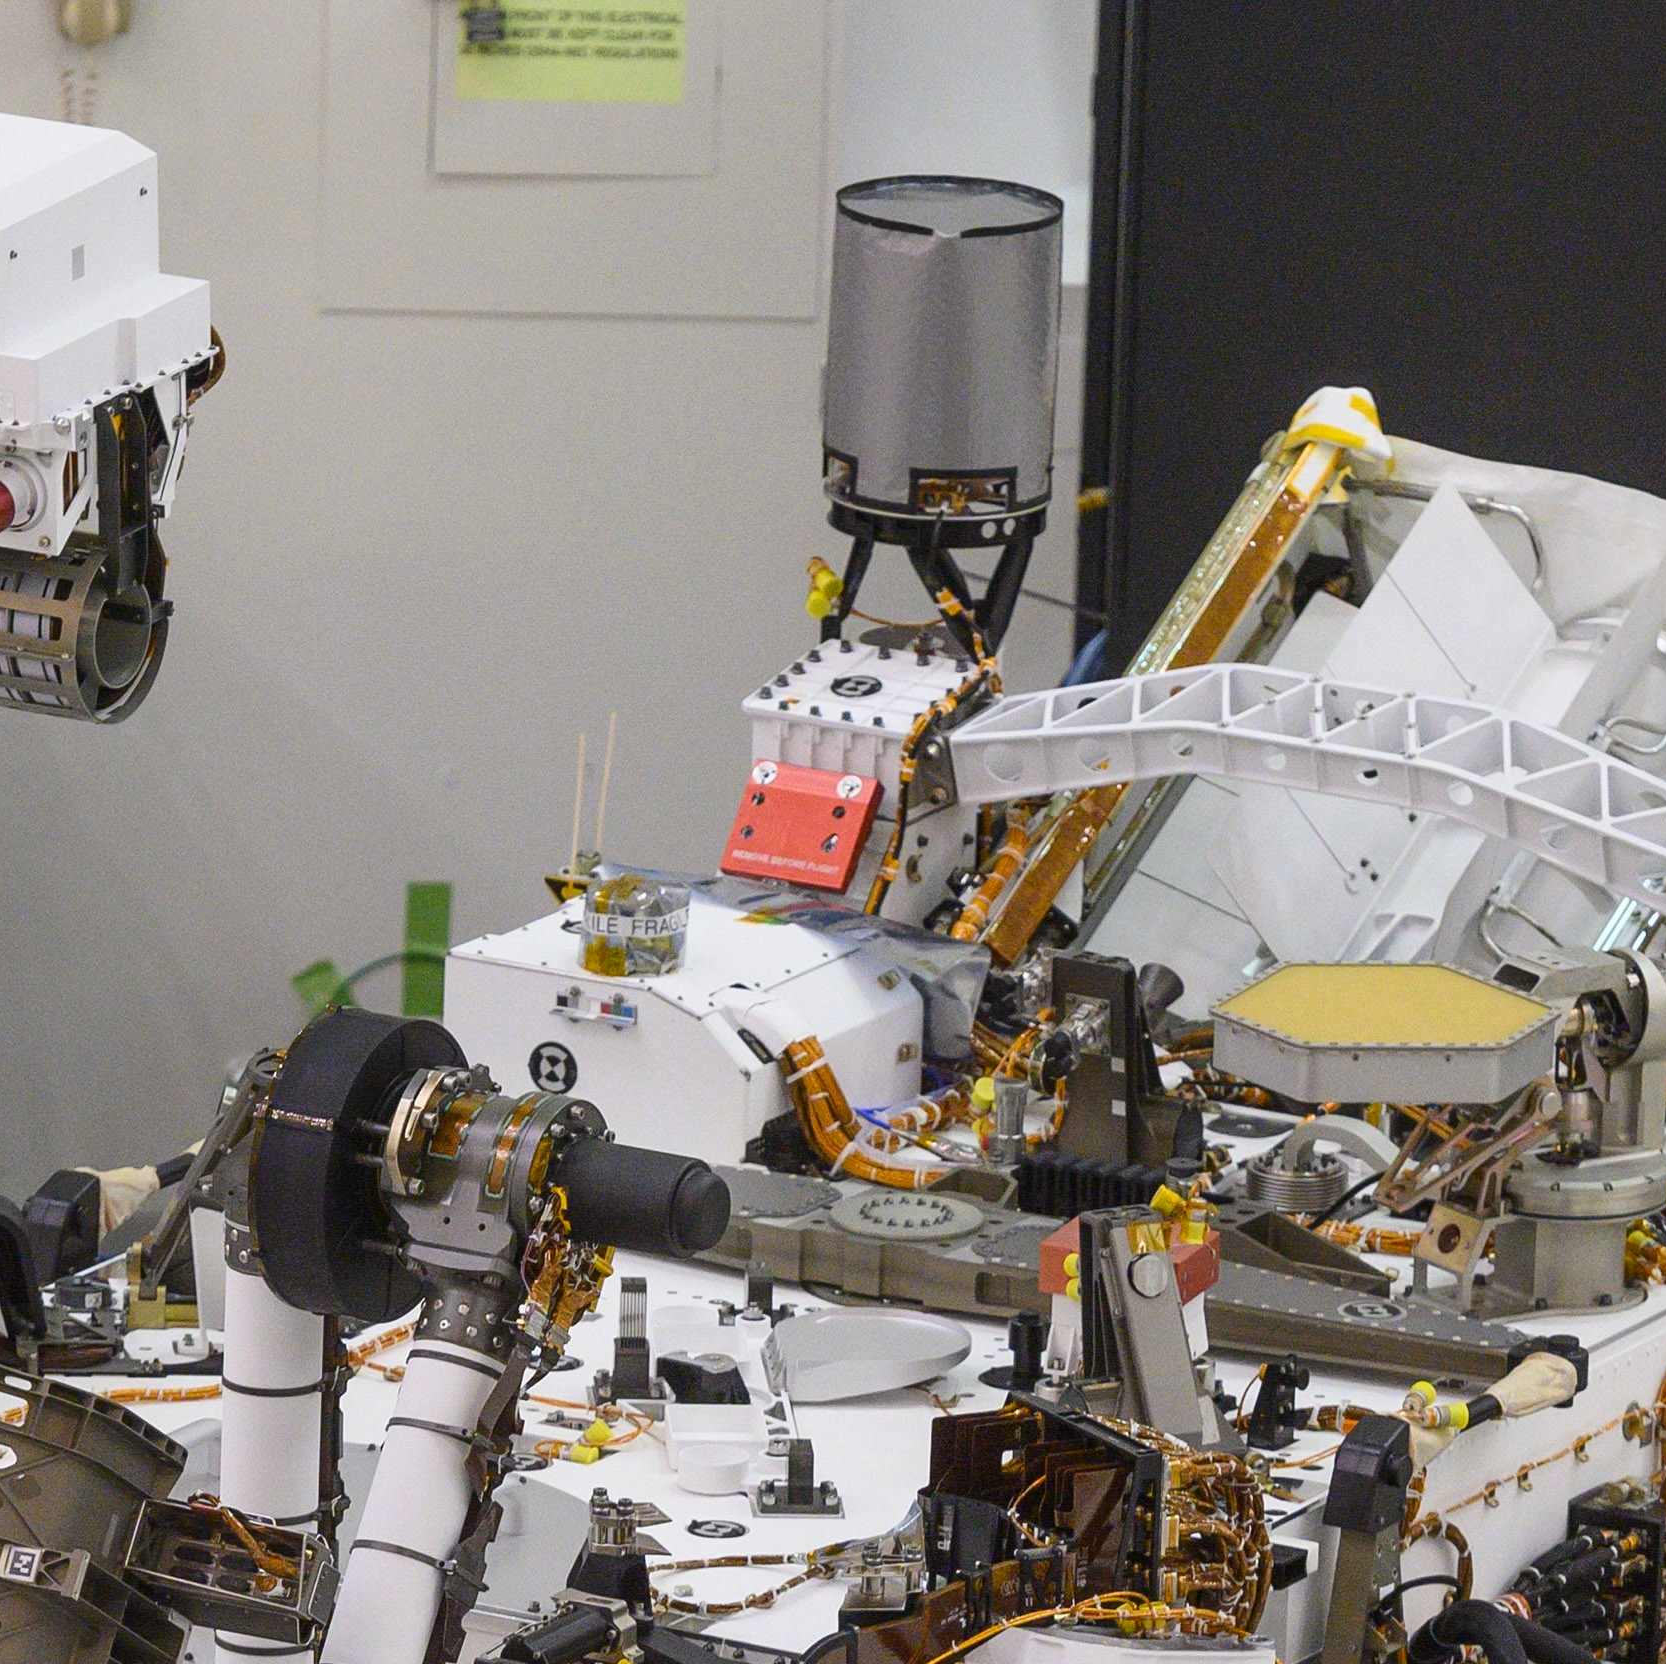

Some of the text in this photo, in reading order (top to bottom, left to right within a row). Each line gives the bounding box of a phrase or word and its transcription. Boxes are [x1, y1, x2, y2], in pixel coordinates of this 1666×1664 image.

[732, 849, 839, 873] REMOVE BEFORE FLIGHT
